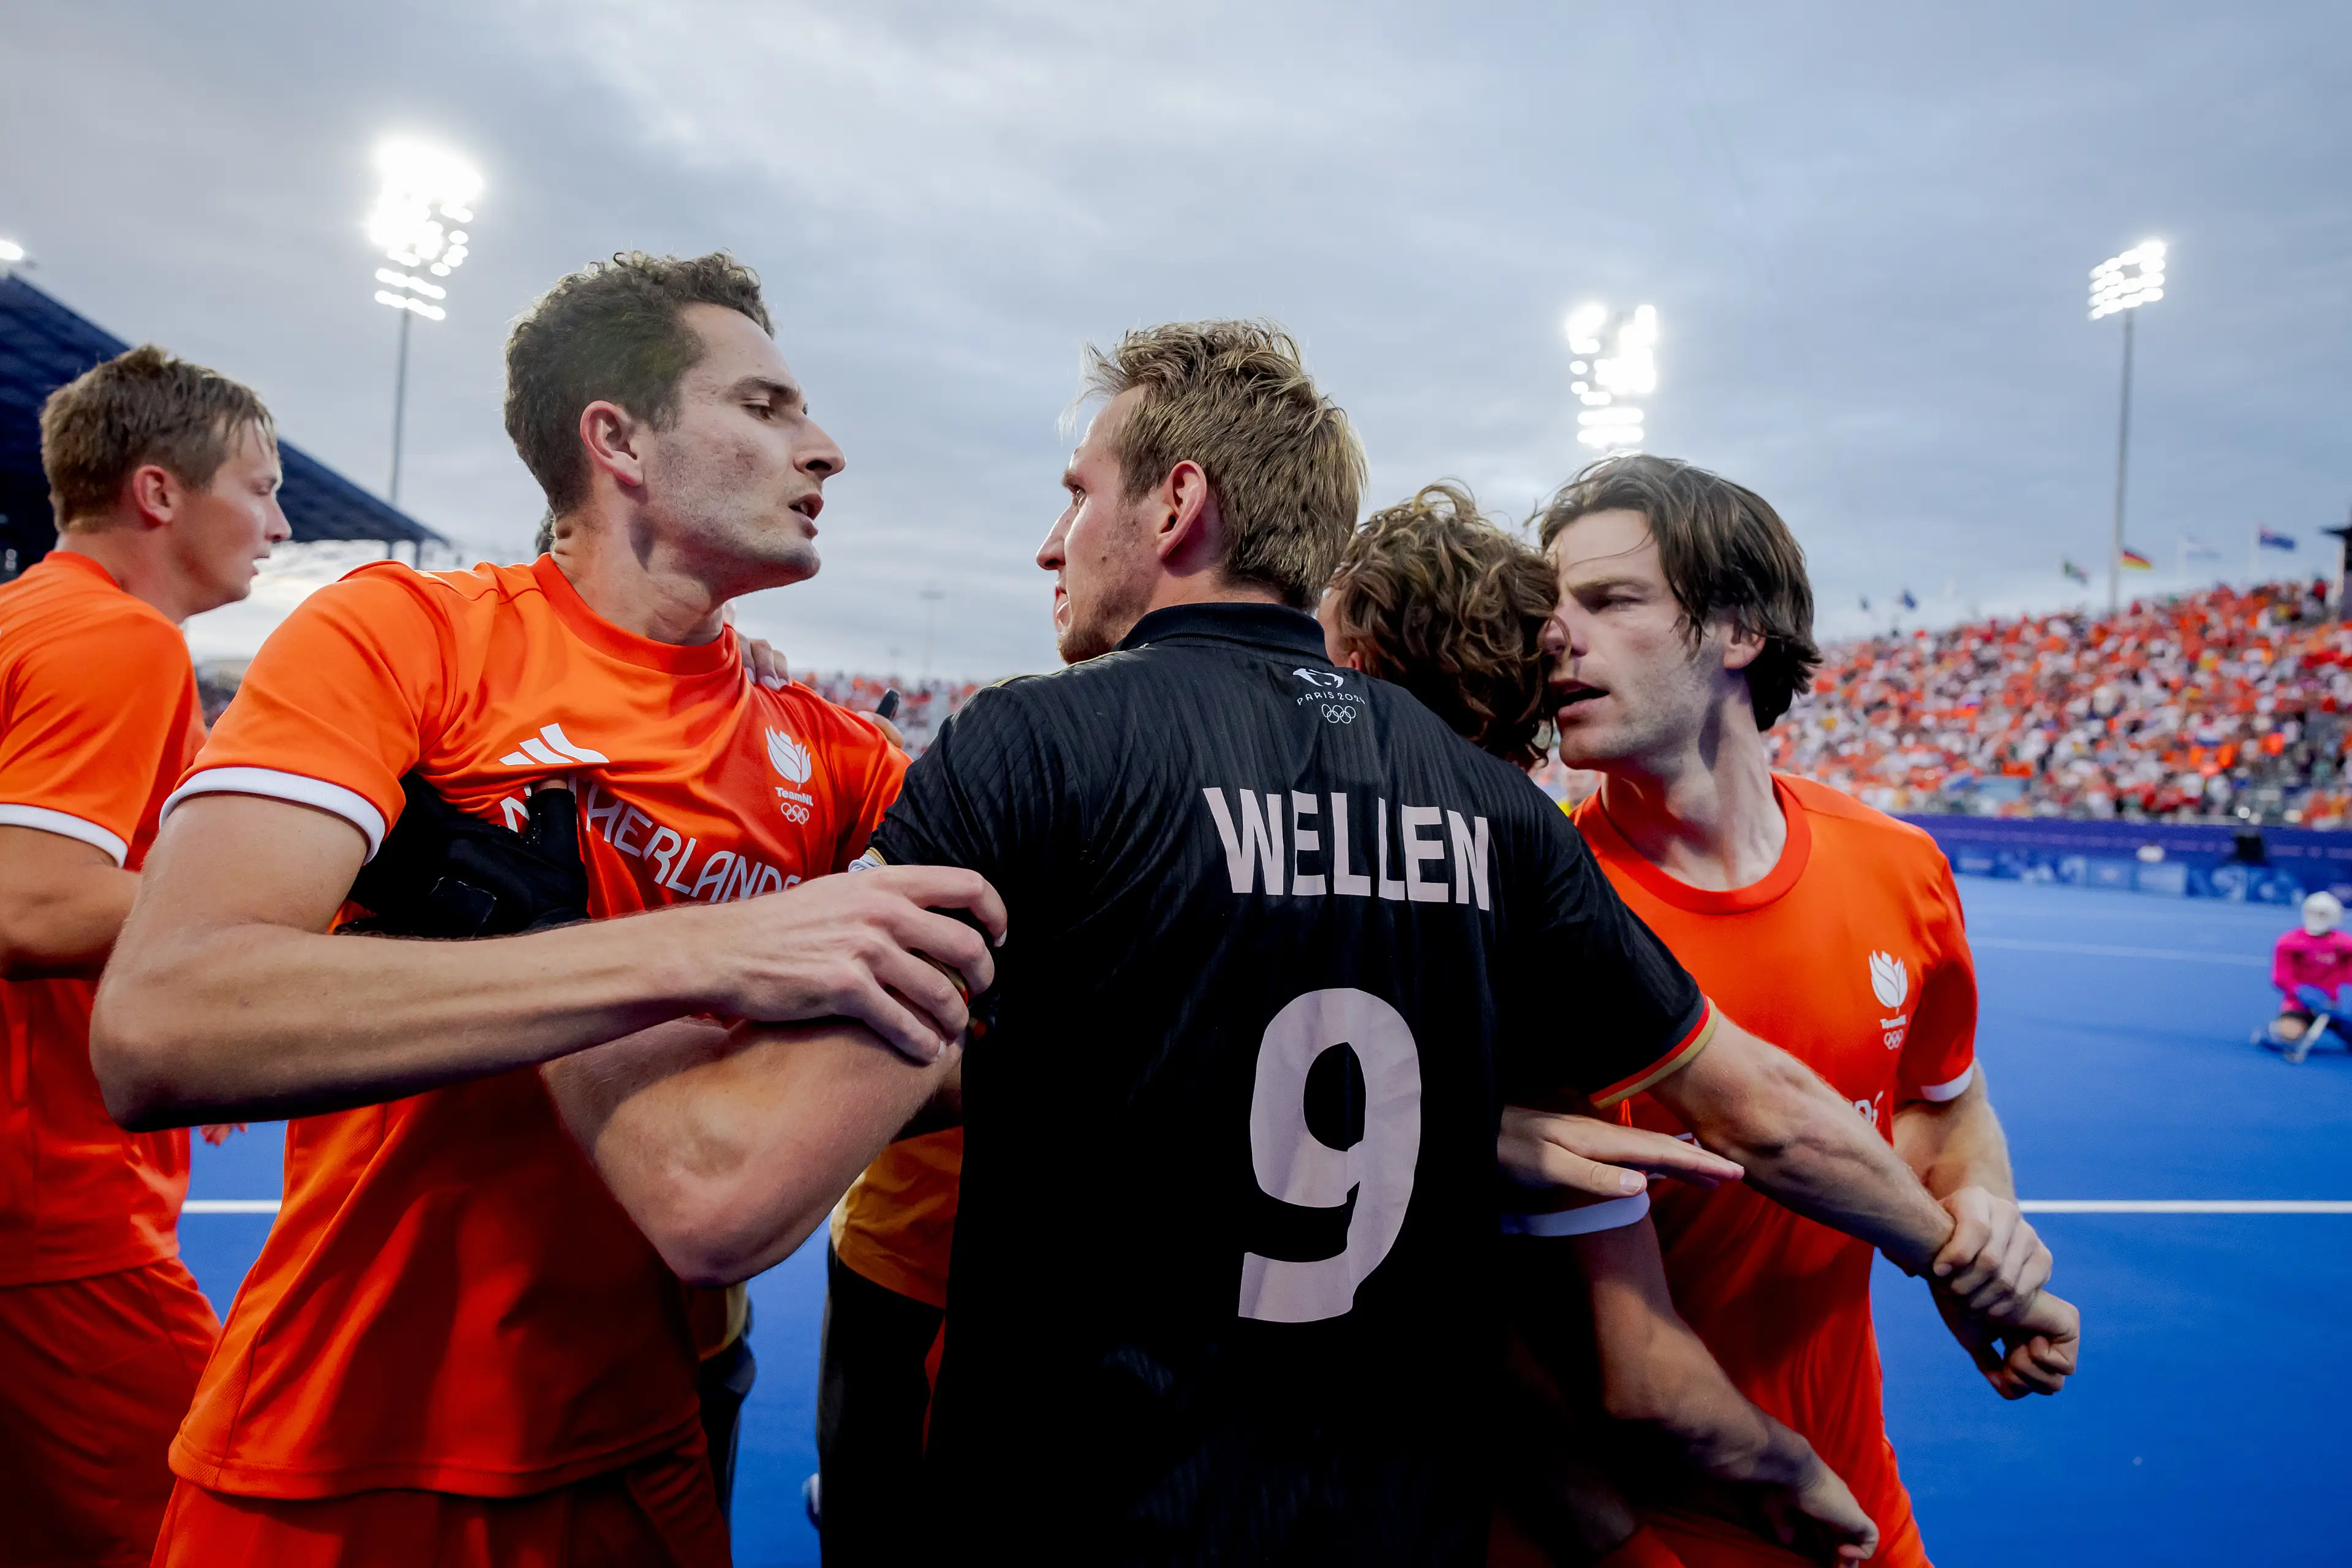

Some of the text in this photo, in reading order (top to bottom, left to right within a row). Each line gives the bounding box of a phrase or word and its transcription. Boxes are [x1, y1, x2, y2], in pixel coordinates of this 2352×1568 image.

[499, 773, 802, 903] NHERLAND
[775, 786, 813, 807] TeamNL
[1202, 787, 1490, 911] WELLEN
[1238, 987, 1422, 1323] 9
